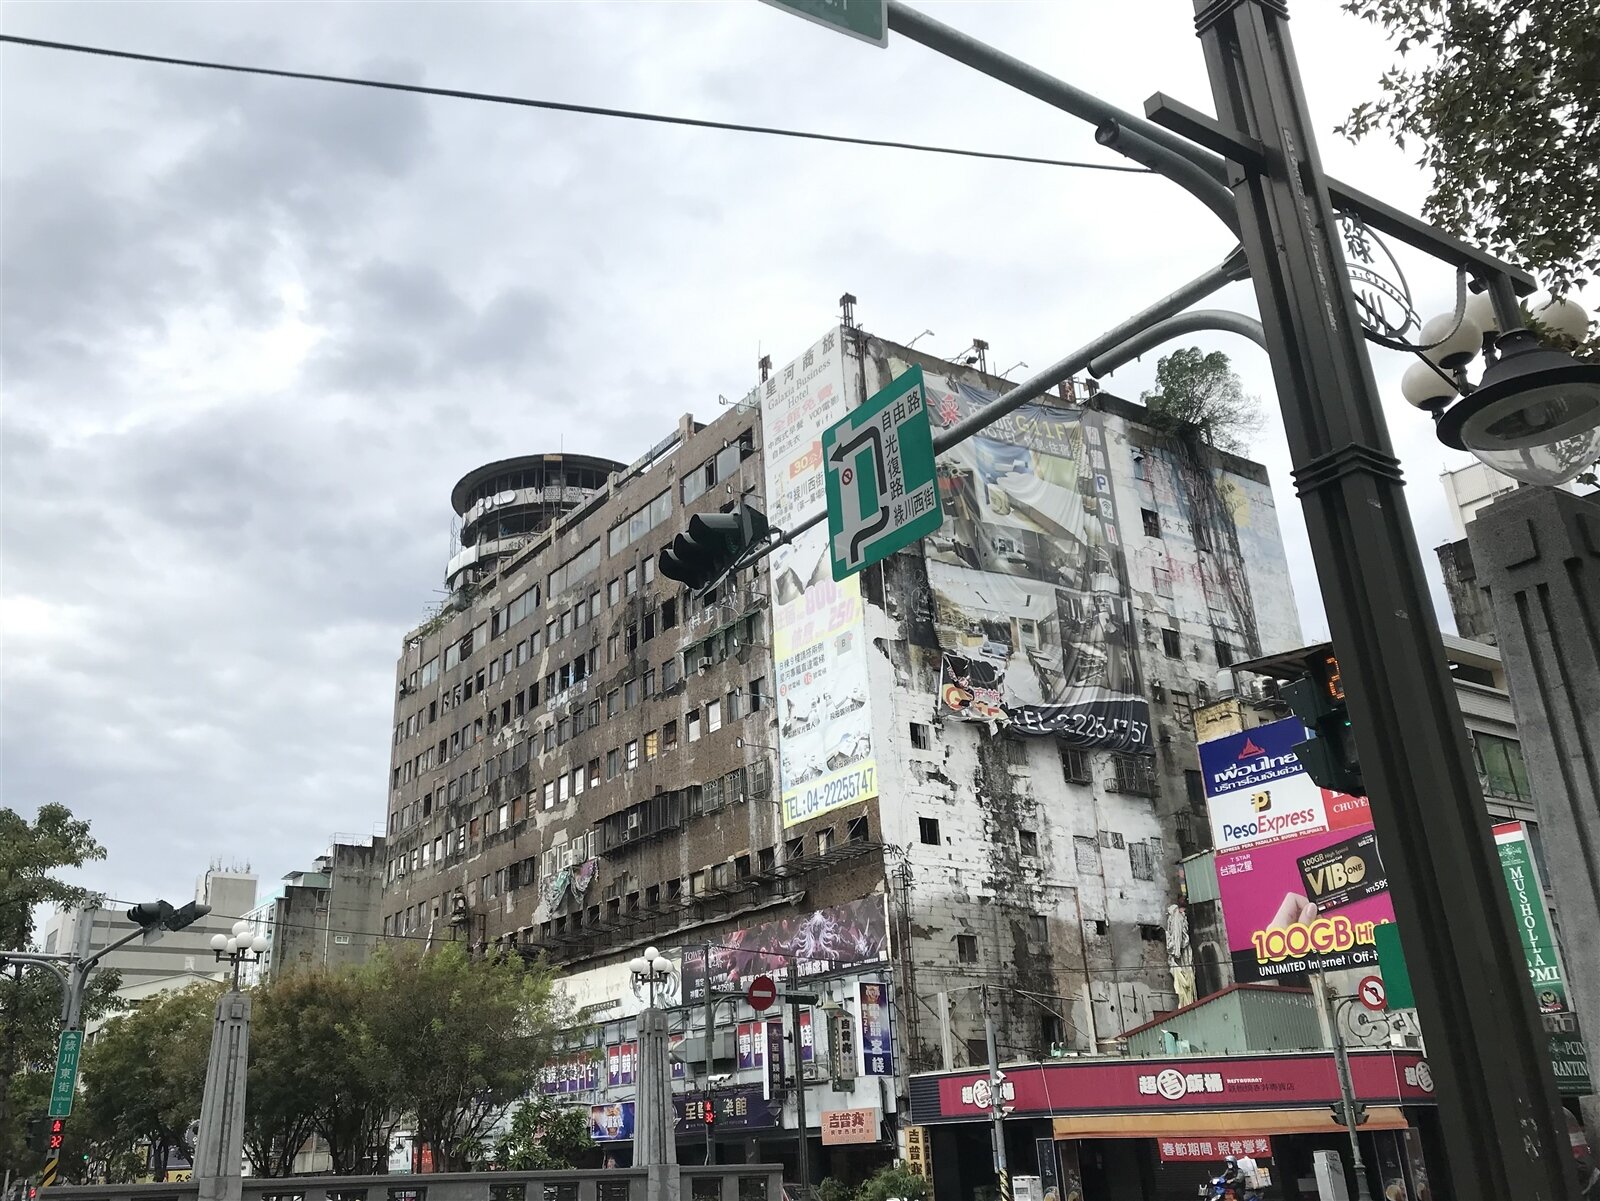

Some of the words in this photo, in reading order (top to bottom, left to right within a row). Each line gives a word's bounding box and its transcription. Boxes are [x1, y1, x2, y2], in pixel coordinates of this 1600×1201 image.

[766, 333, 835, 399] 星河商旅
[768, 386, 795, 410] Galaxia
[796, 358, 831, 390] Business
[788, 385, 809, 408] Hotel
[882, 390, 921, 432] 自由路
[885, 433, 905, 501] 光復路
[894, 487, 935, 527] 綠川西街
[1214, 752, 1299, 783] เพื่อนไทย
[784, 768, 874, 821] TEL:04-22255747
[1223, 808, 1315, 841] PesoExpress
[1220, 861, 1254, 877] 台灣之星
[1235, 854, 1251, 862] STAR
[1302, 853, 1325, 867] 100GB
[1347, 864, 1363, 875] ONE
[1509, 866, 1546, 967] MUSHOLLA
[1254, 917, 1352, 962] 100GB
[1259, 962, 1306, 977] UNLIMITED
[1308, 954, 1346, 971] Internet
[58, 1040, 77, 1093] 綠川東街
